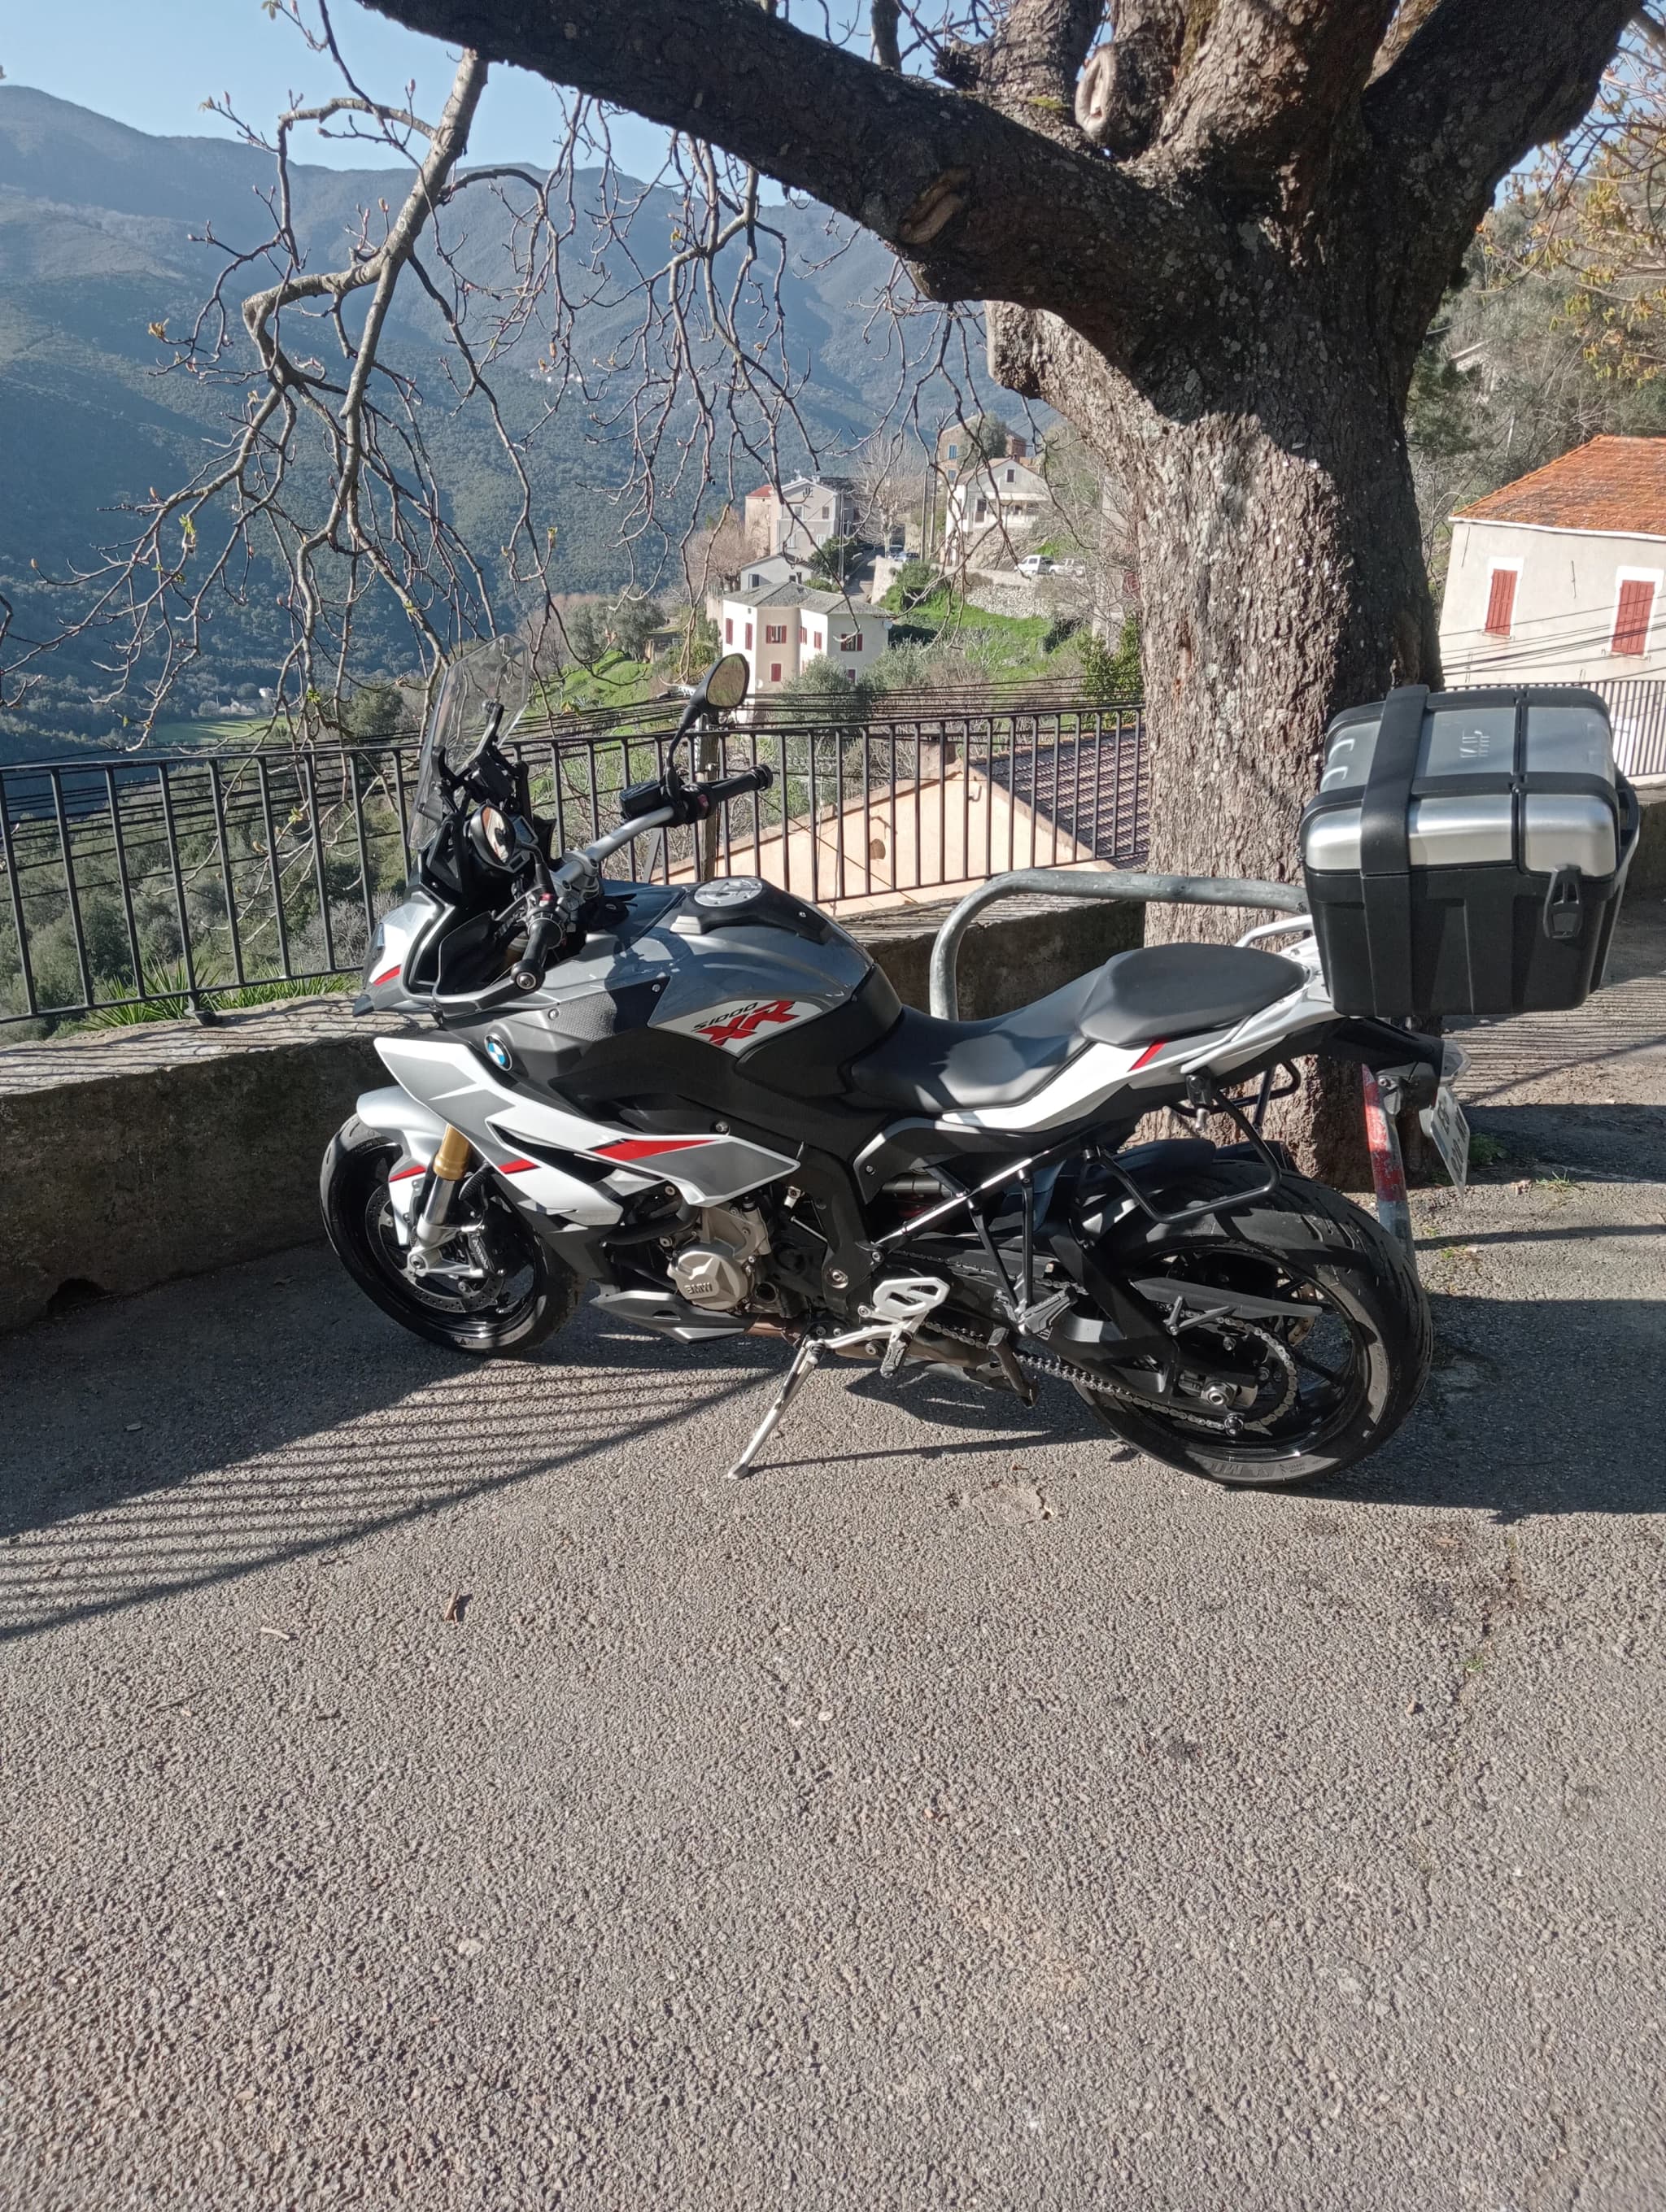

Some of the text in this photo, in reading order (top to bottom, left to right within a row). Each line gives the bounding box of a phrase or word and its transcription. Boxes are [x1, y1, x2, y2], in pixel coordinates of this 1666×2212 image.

[692, 1002, 758, 1030] S1000
[696, 1000, 800, 1046] XR
[684, 1282, 713, 1294] BMW
